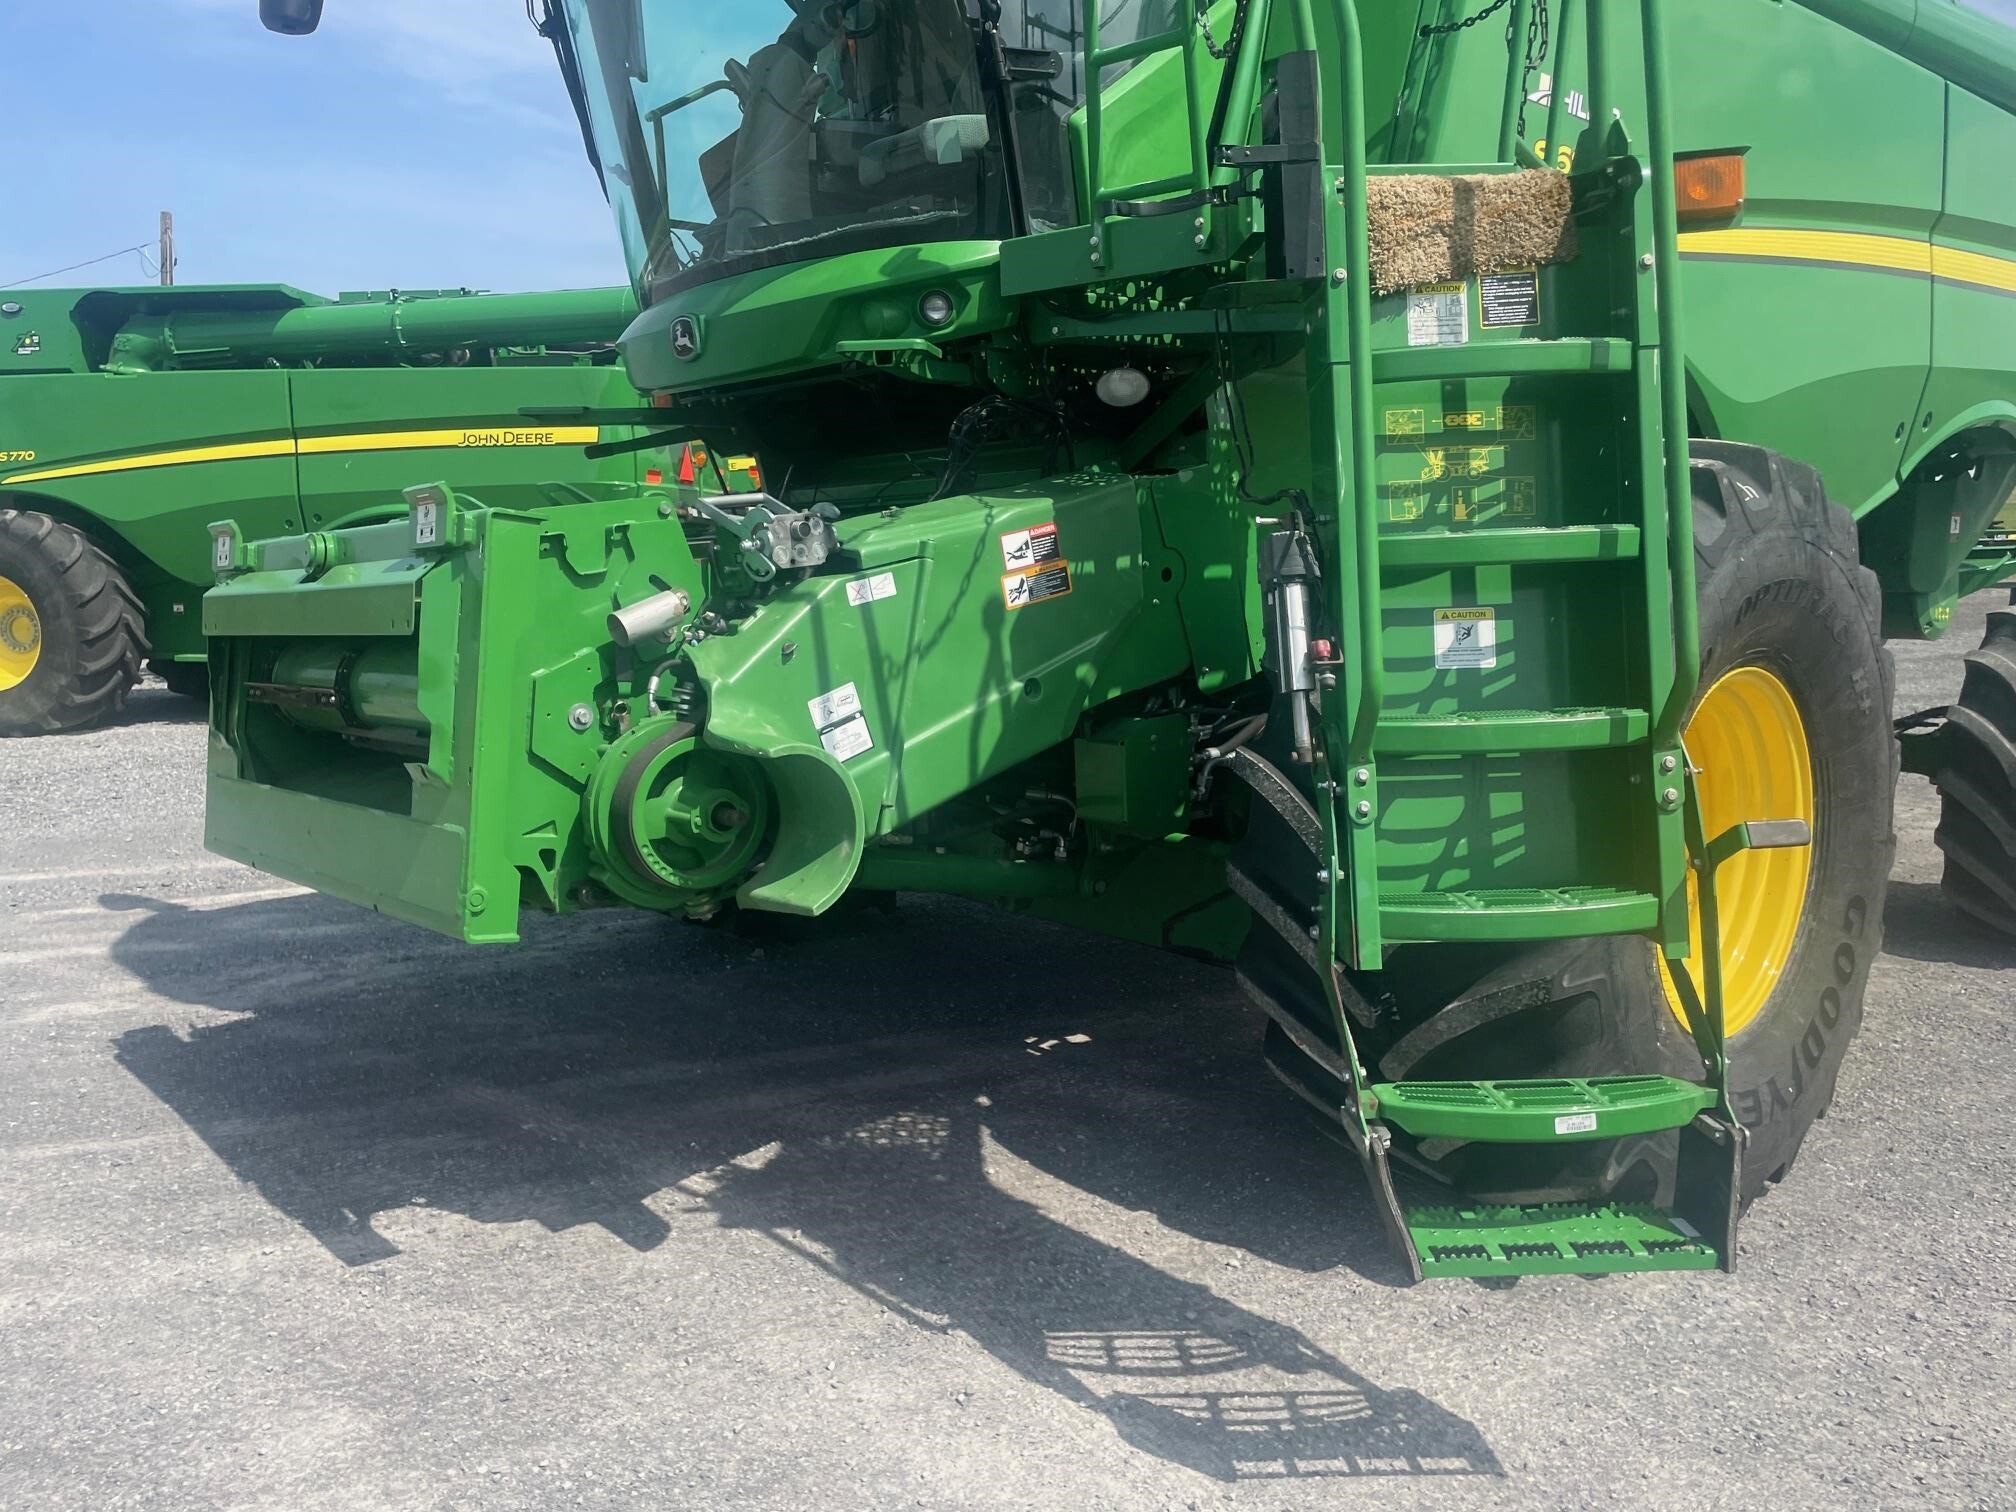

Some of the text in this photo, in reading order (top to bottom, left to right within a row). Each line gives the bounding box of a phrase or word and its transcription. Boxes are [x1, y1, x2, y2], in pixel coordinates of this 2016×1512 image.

[1424, 284, 1461, 294] CAUTION
[458, 431, 555, 446] JOHN DEERE
[1034, 525, 1056, 536] DANGER
[1450, 611, 1487, 620] CAUTION
